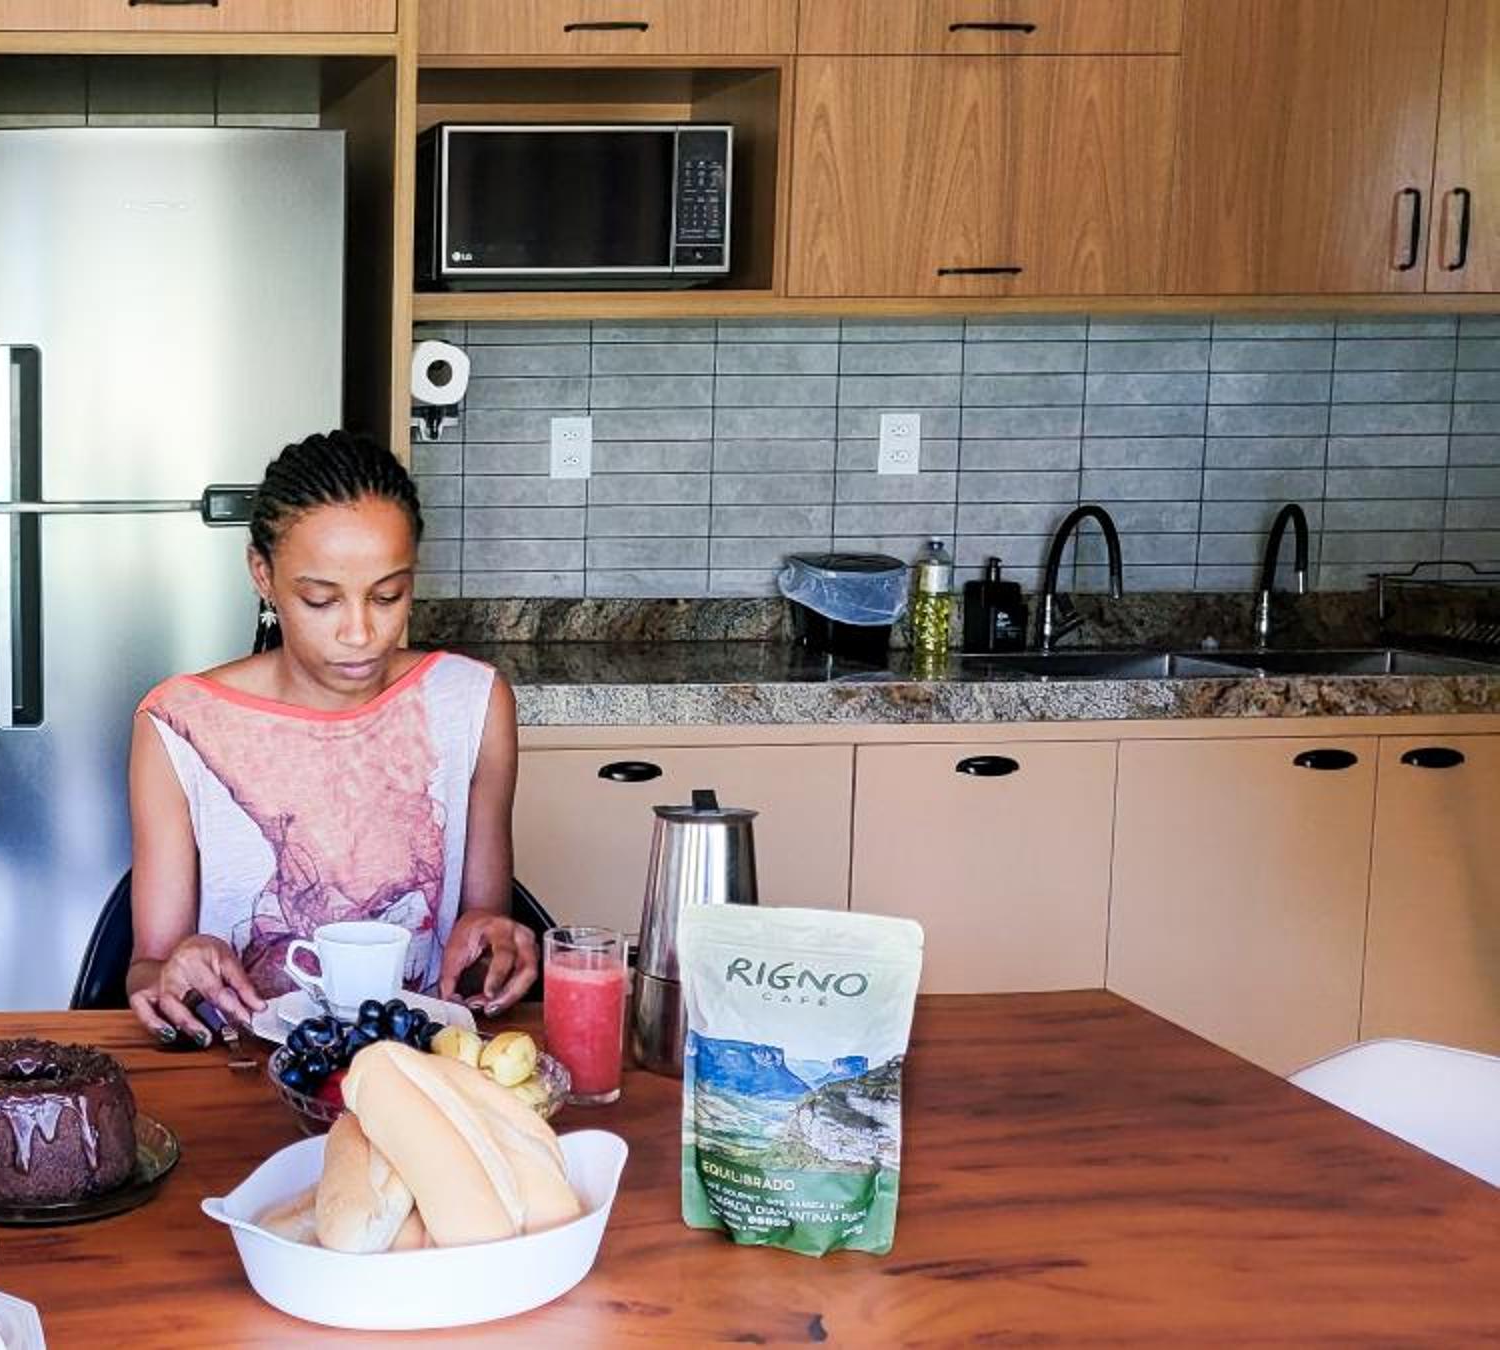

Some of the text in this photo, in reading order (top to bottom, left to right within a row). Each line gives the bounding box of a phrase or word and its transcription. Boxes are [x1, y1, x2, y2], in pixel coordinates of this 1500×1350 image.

[725, 957, 869, 997] RIGNO
[702, 1160, 796, 1192] EQUILIBRADO
[755, 1205, 833, 1224] DIAMANTINA
